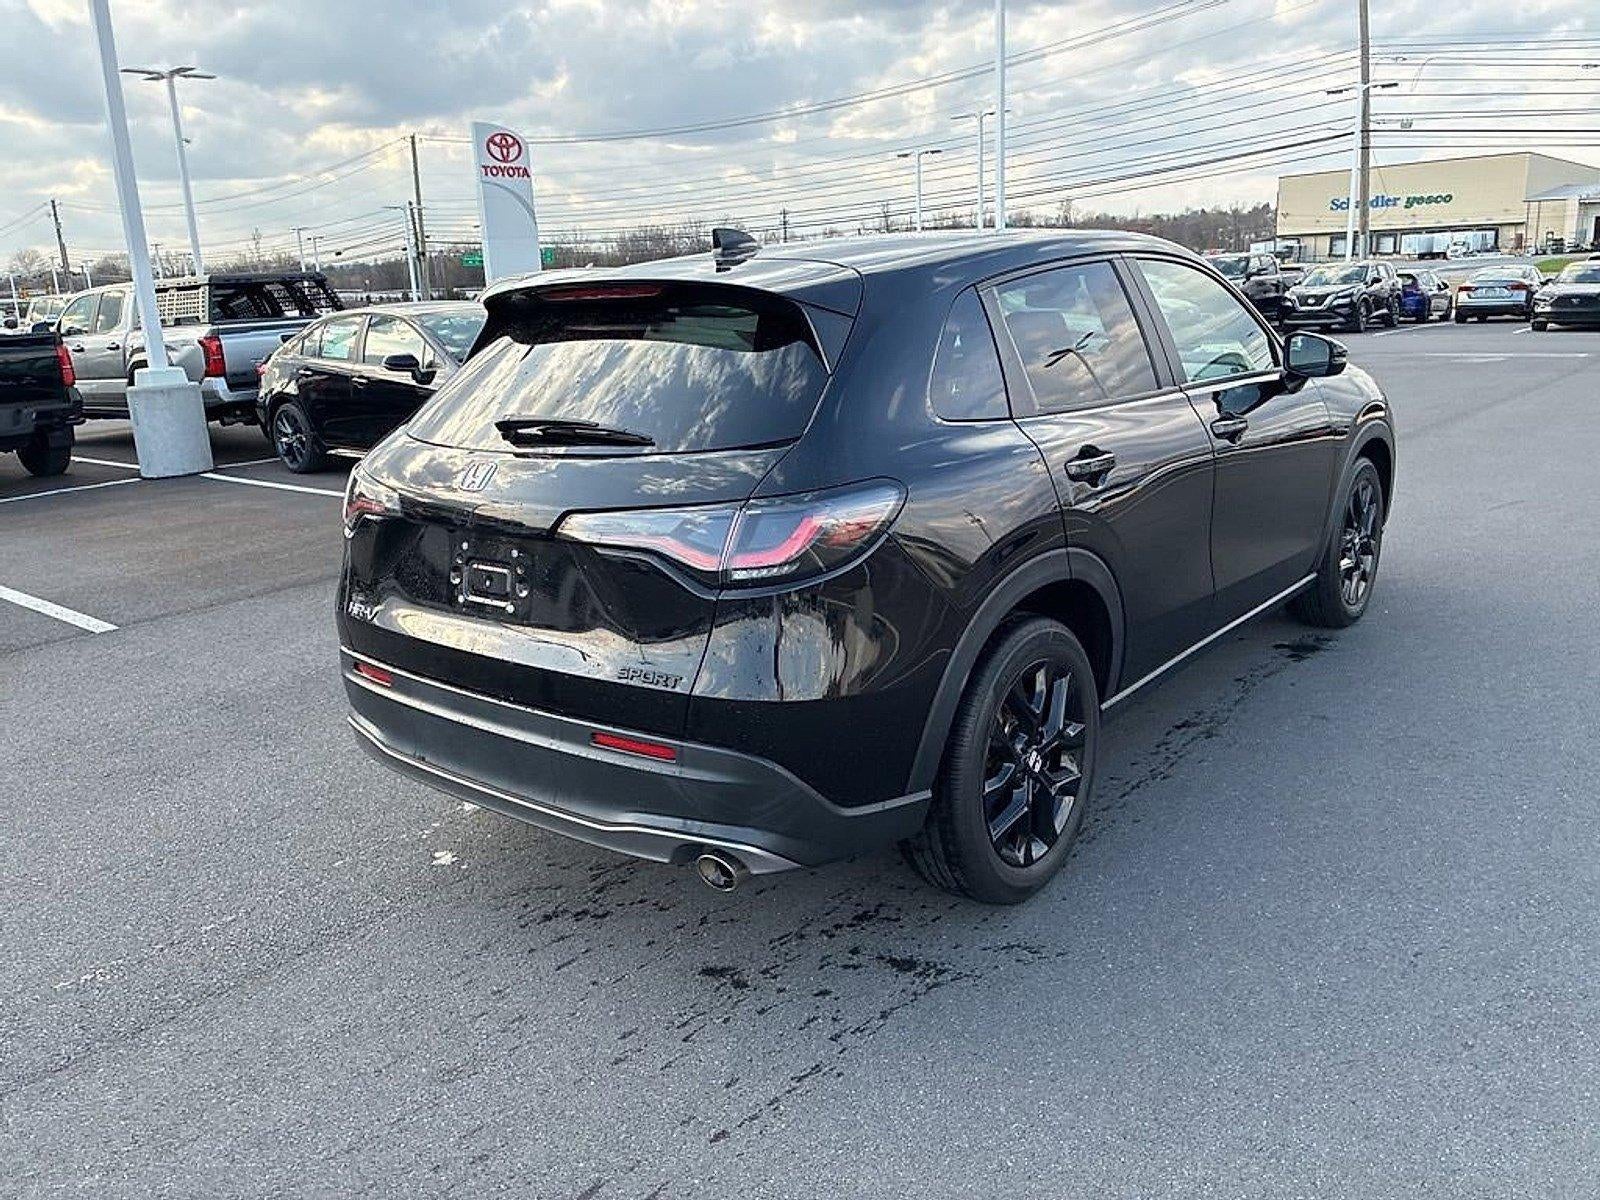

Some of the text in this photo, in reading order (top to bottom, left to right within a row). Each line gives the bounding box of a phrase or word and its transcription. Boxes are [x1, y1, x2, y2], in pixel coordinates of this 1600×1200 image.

[481, 165, 531, 179] TOYOTA
[1330, 193, 1453, 210] Scdler yesco
[617, 667, 684, 689] SPORT
